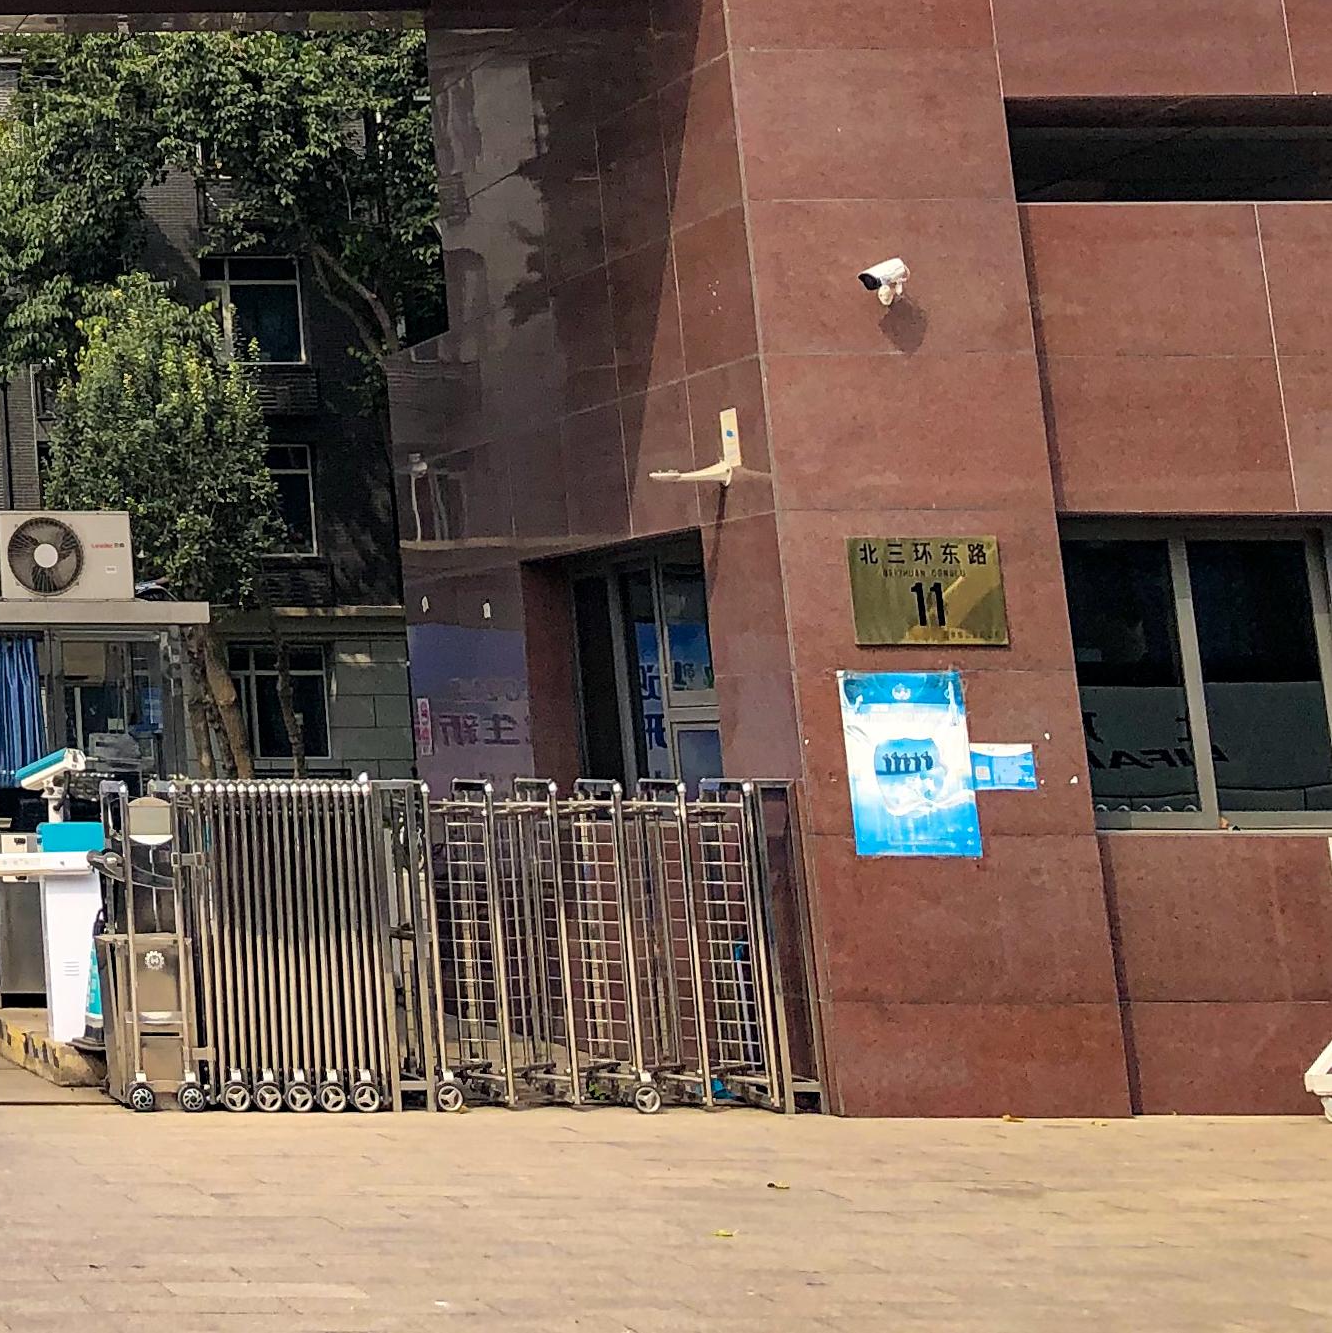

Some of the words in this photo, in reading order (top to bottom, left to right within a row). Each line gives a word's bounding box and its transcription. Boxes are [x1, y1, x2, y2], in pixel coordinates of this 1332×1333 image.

[859, 542, 987, 565] 北三环东路
[910, 582, 946, 627] 11
